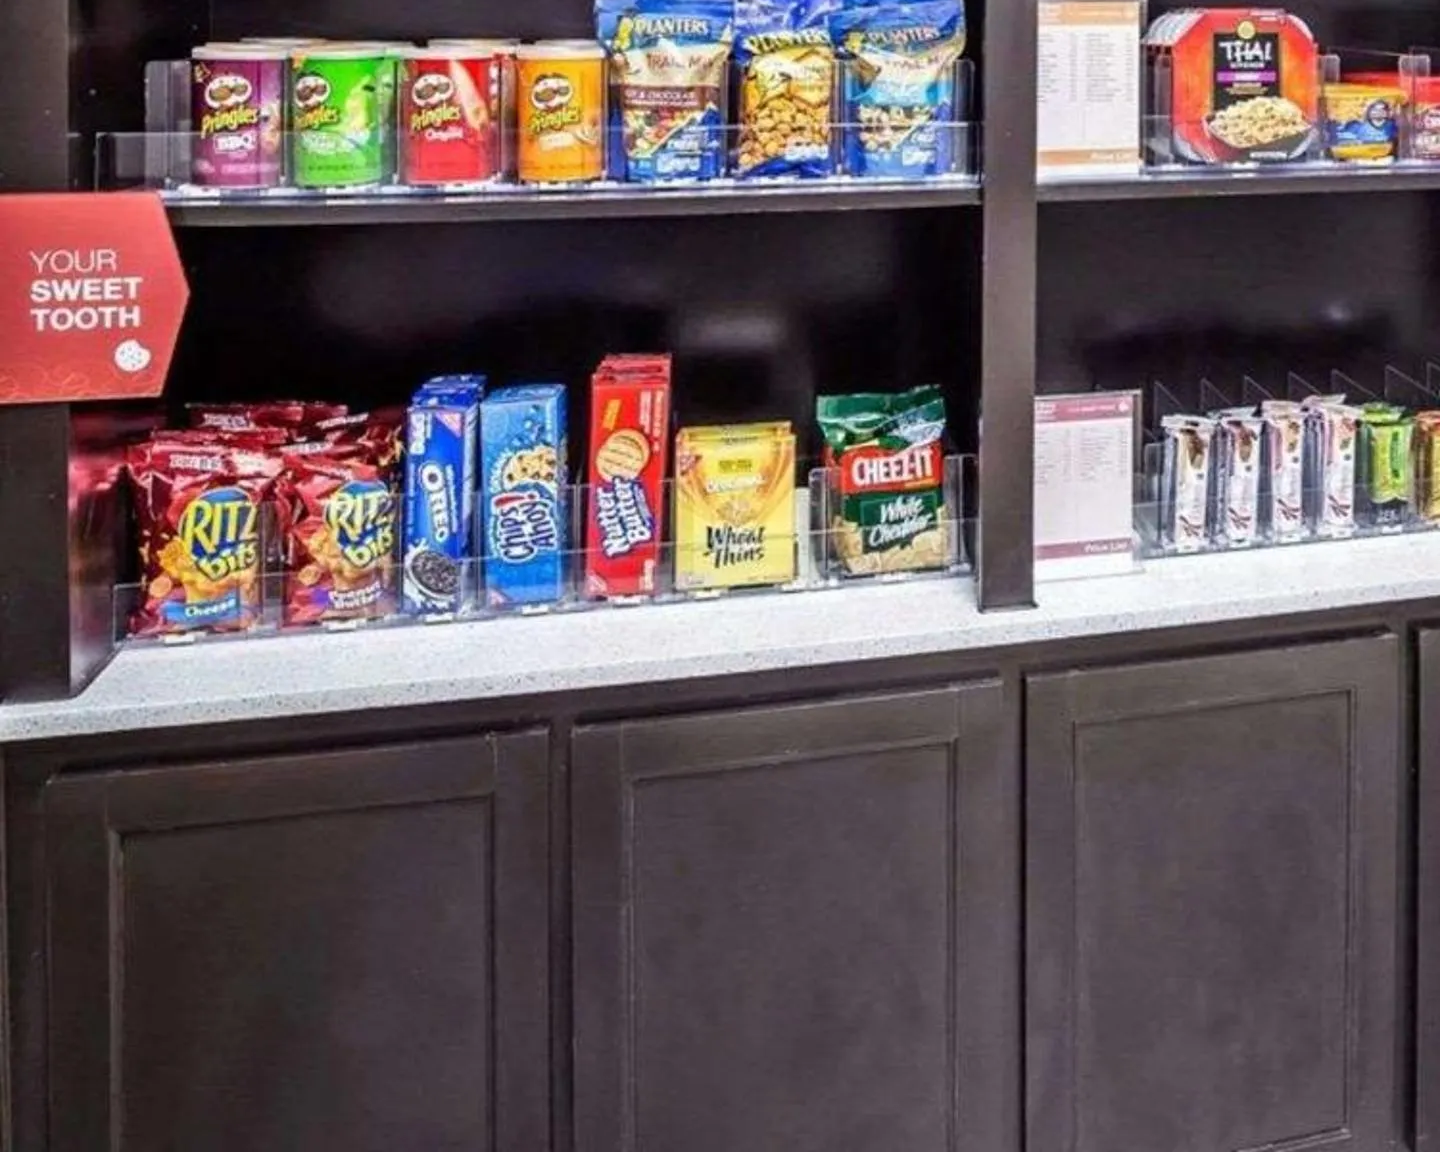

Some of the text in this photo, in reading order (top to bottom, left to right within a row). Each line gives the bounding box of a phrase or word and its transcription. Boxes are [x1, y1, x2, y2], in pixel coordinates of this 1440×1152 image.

[634, 17, 709, 35] PLANTERS
[1218, 40, 1273, 62] THAI
[30, 249, 117, 274] YOUR
[30, 277, 144, 303] SWEET
[30, 305, 141, 332] TOOTH
[852, 446, 934, 486] CHEEZ-IT
[329, 492, 395, 542] RITZ
[420, 462, 448, 542] OREO
[596, 486, 630, 556] Nutter
[611, 477, 652, 544] Butter
[184, 500, 259, 557] RITZ
[497, 506, 534, 561] Chips
